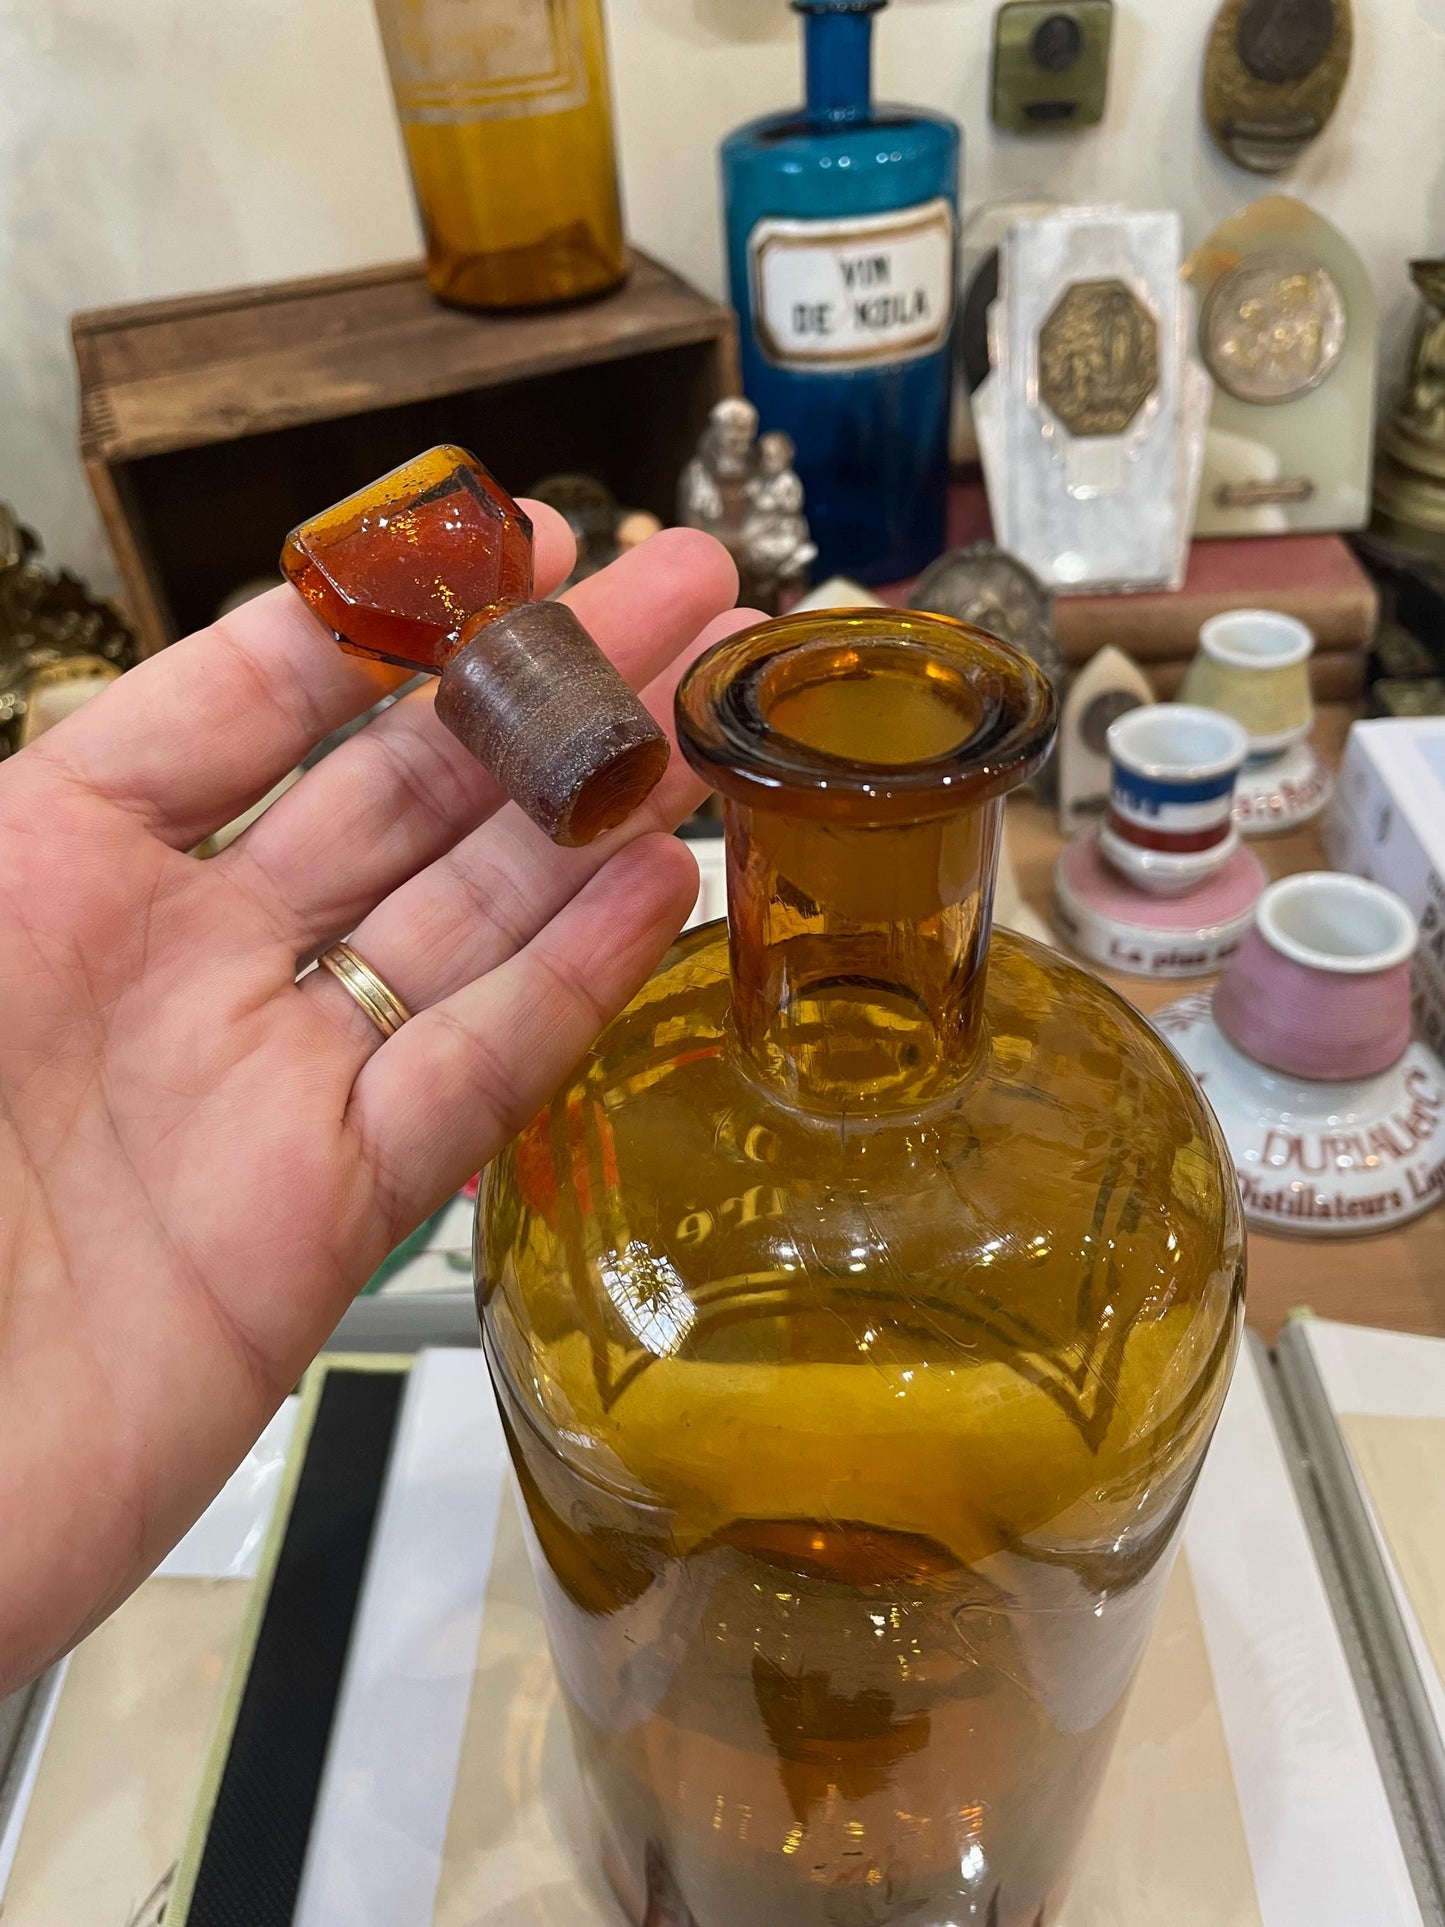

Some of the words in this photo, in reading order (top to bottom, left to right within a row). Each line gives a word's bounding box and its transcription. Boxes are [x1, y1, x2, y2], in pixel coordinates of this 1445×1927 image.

[841, 254, 891, 287] VIN
[792, 302, 831, 335] DE
[854, 288, 930, 330] KOLA
